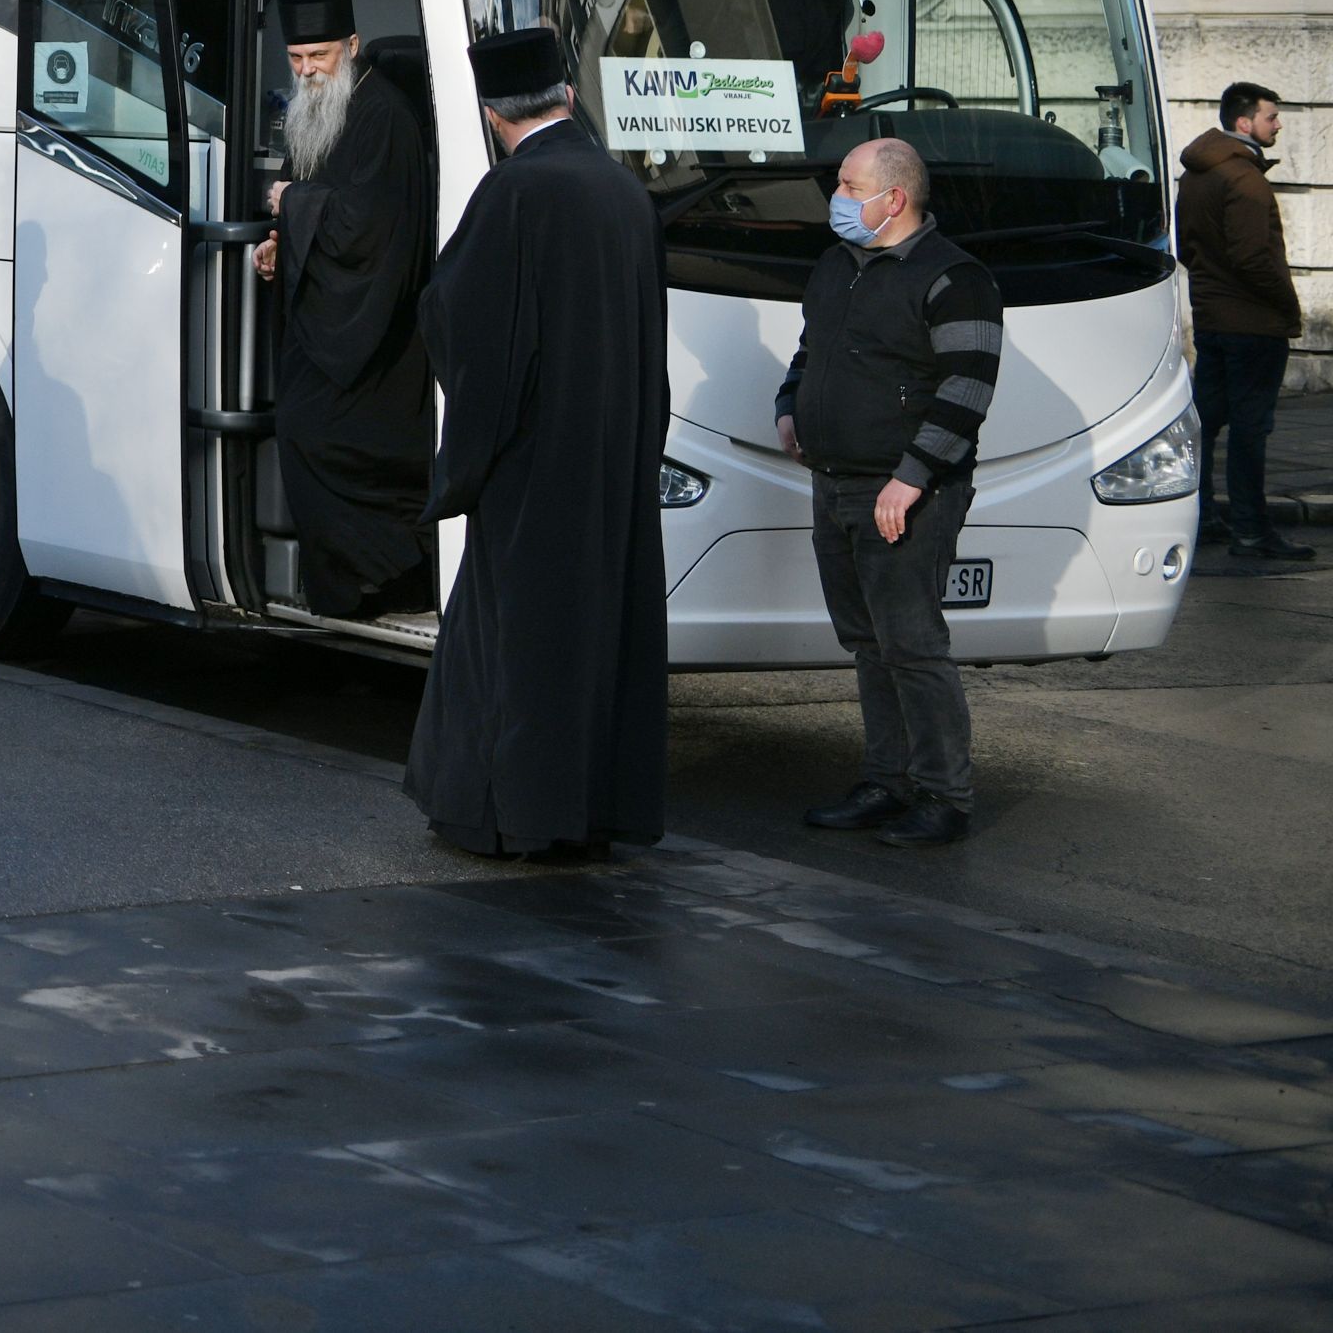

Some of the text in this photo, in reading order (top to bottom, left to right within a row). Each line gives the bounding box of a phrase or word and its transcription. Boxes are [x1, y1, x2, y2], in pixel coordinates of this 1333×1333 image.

[623, 69, 775, 98] KAVIM Jedinstvo
[617, 116, 793, 134] VANLINIJSKI PREVOZ
[138, 147, 165, 176] УЛАЗ
